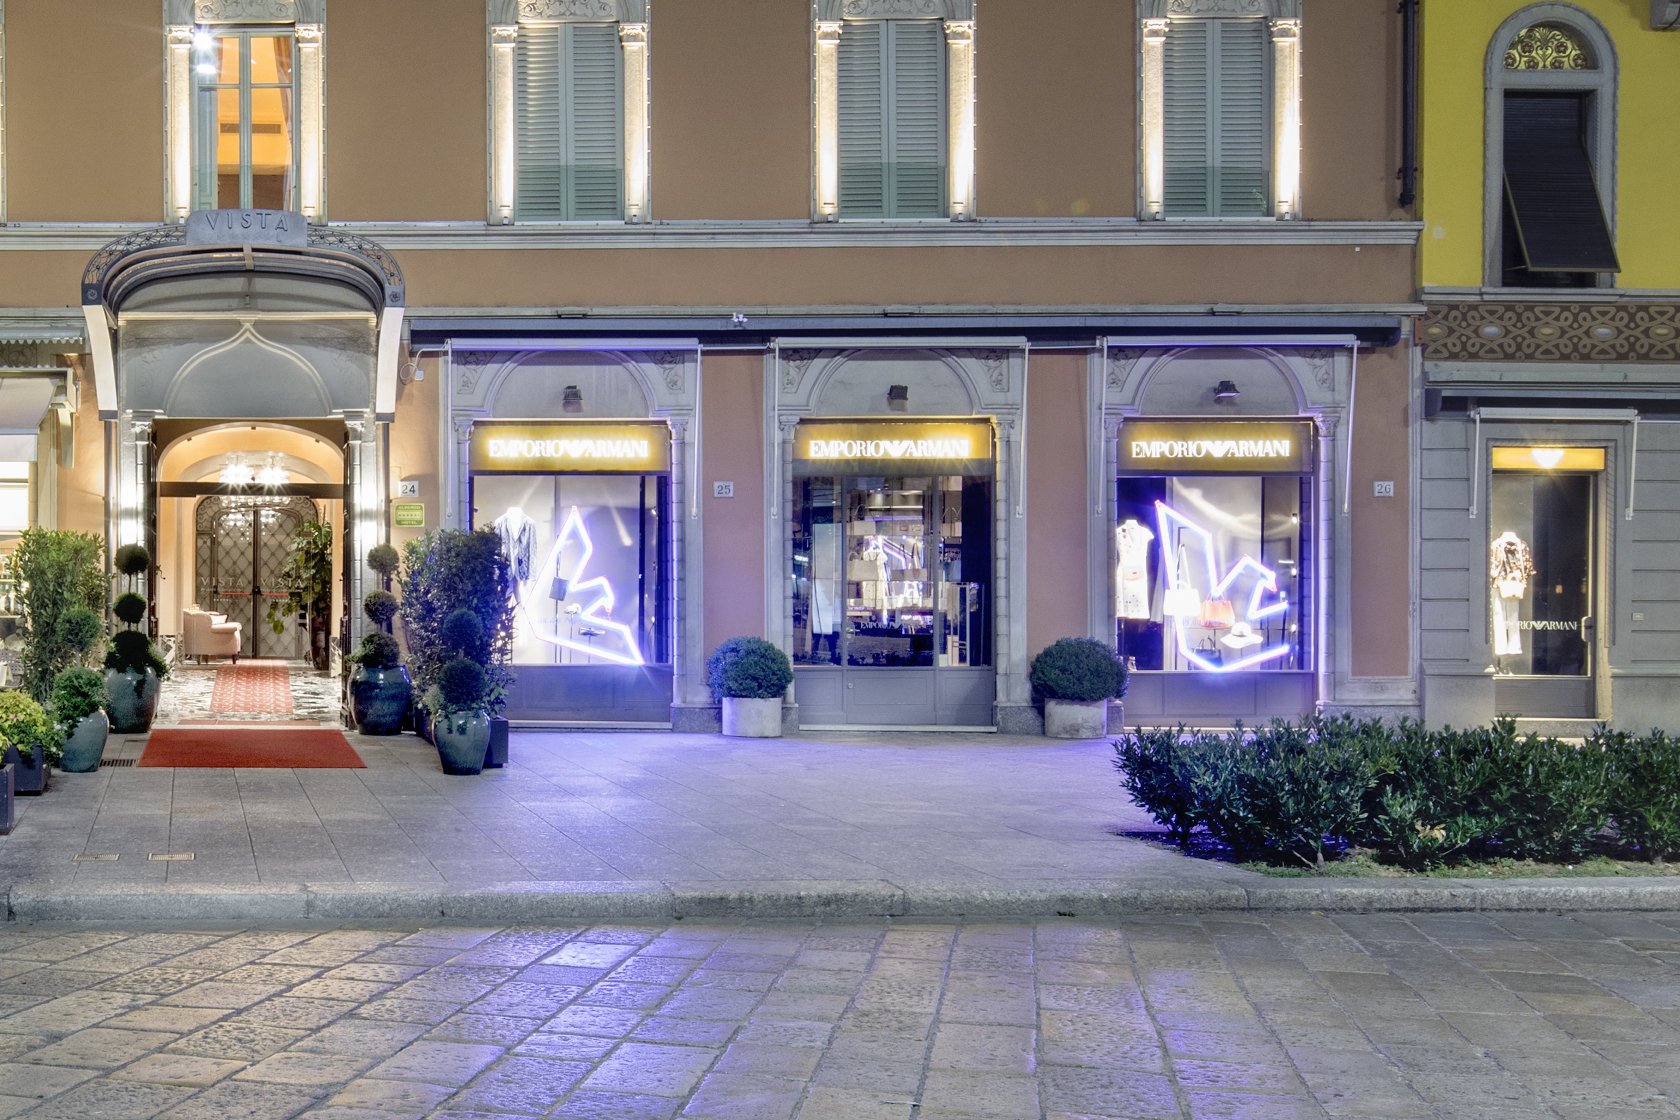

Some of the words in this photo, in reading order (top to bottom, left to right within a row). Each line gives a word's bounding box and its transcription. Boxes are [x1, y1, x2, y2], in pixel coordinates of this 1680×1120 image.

[205, 212, 288, 232] VISTA
[488, 439, 563, 458] EMPORIO
[584, 439, 649, 458] ARMANI
[809, 439, 885, 458] EMPORIO
[905, 439, 970, 458] ARMANI
[1131, 439, 1206, 458] EMPORIO
[1227, 439, 1291, 458] ARMANI
[401, 484, 416, 495] 24
[717, 484, 731, 495] 25
[1376, 483, 1391, 494] 26
[200, 576, 244, 586] VISTA
[260, 578, 304, 588] VISTA
[1543, 620, 1577, 630] ARMANI
